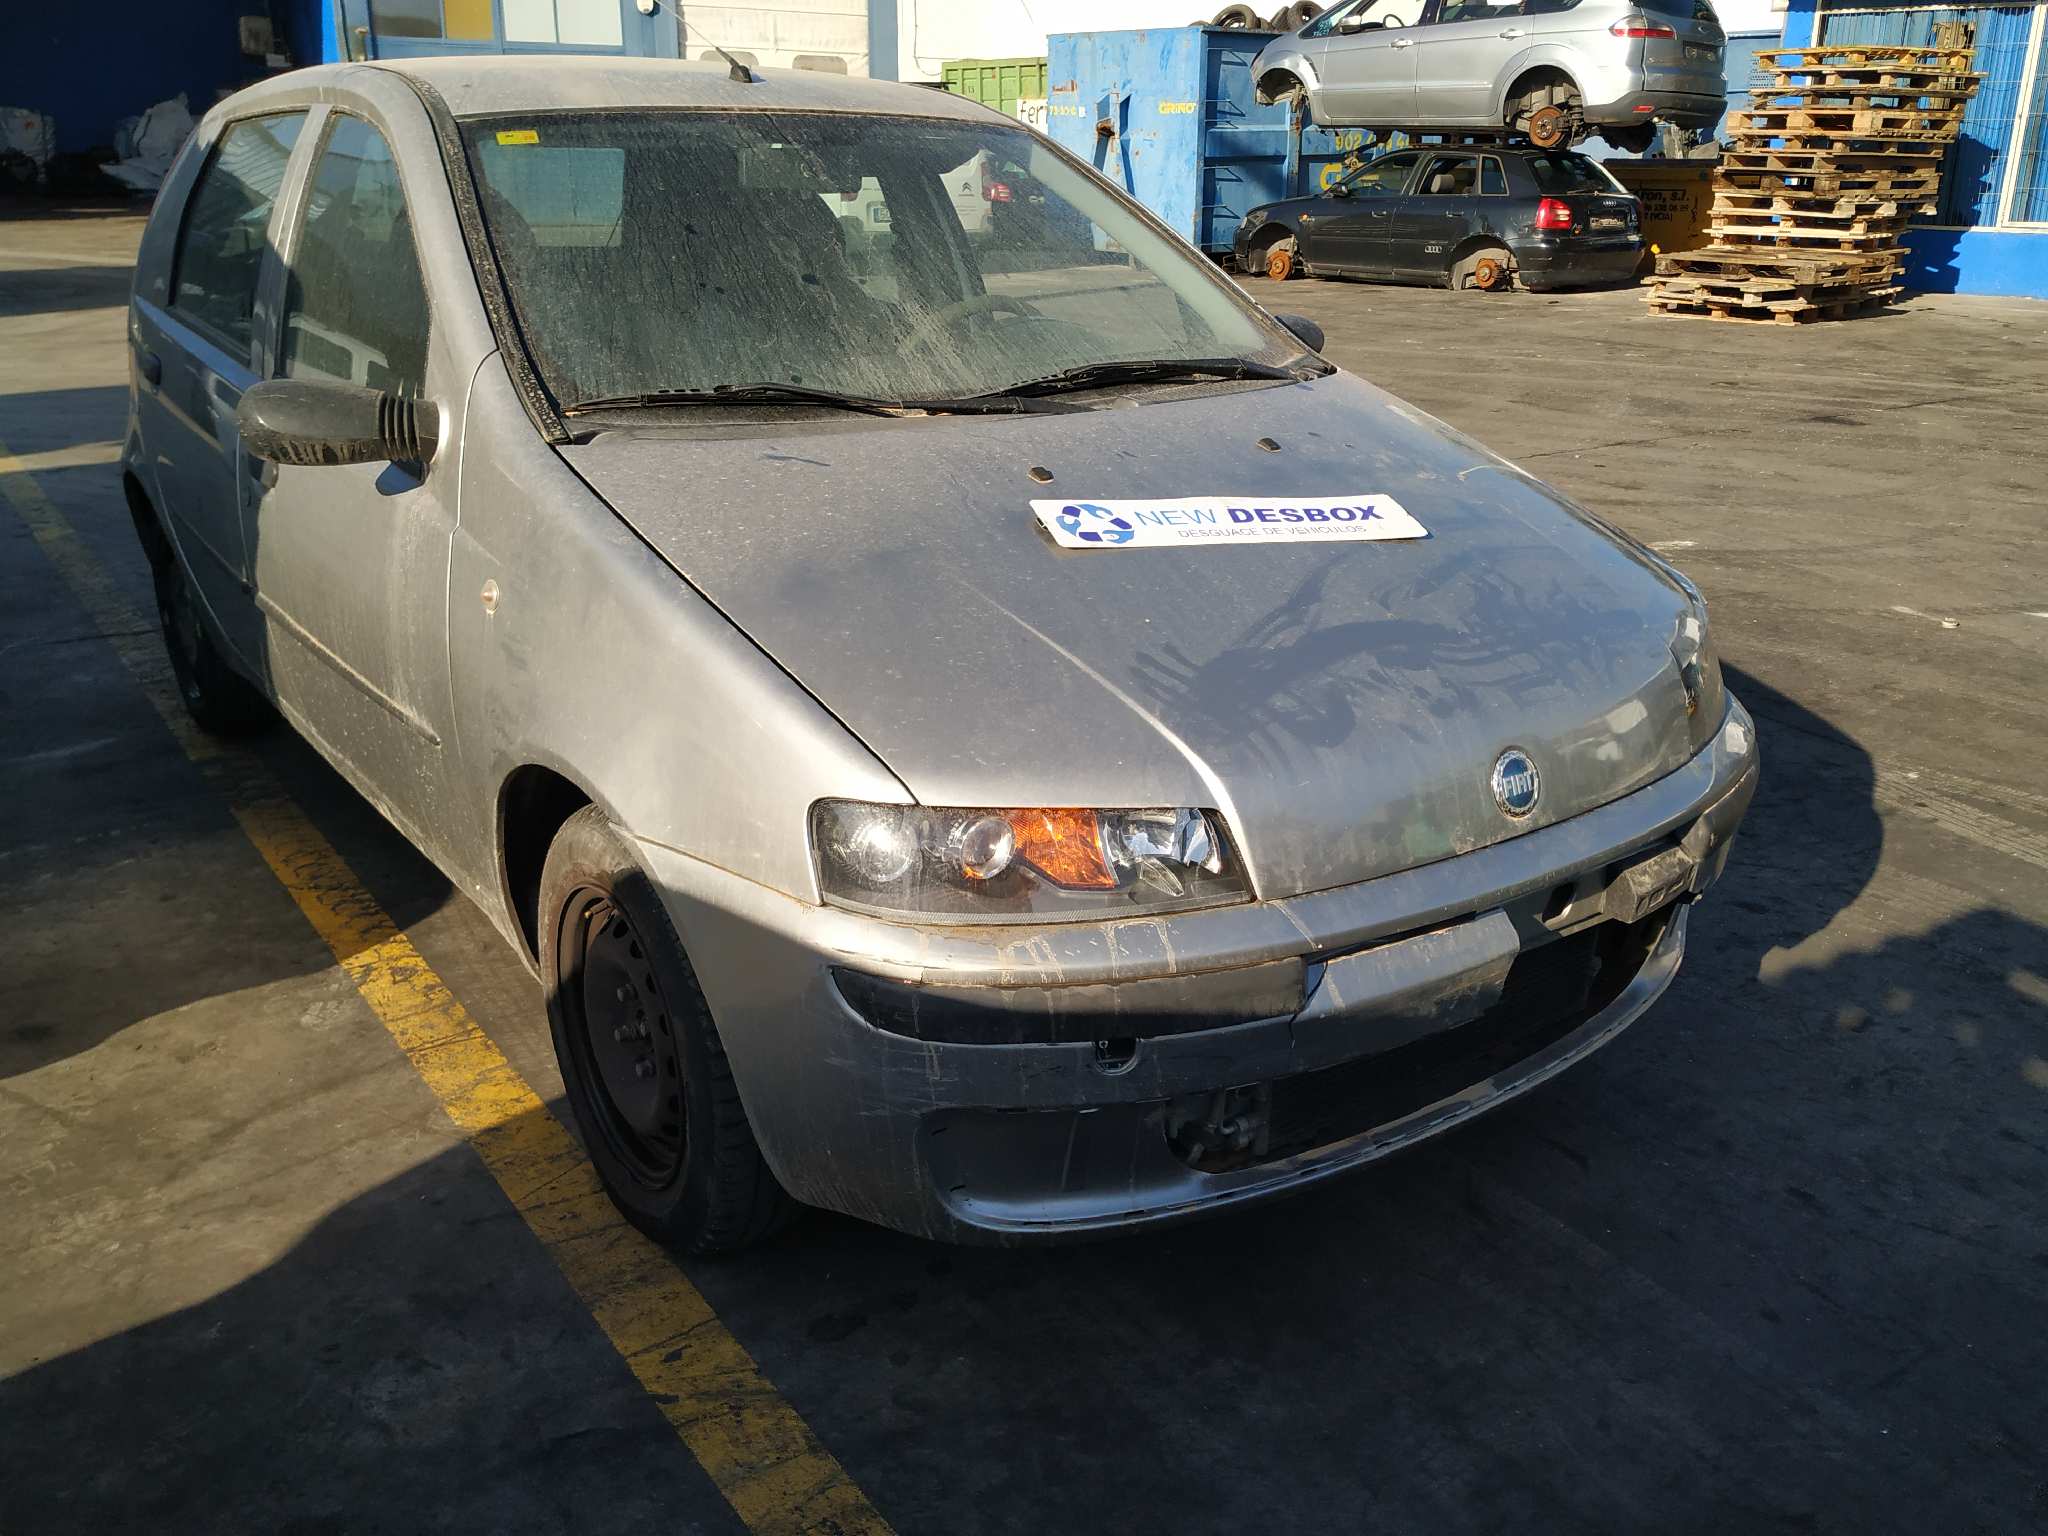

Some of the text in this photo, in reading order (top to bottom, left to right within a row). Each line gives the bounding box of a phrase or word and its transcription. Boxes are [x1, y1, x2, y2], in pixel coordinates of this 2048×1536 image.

[1134, 505, 1385, 526] NEW DESBOX
[1177, 527, 1258, 539] DESGUACE
[1263, 526, 1284, 537] DE
[1502, 770, 1533, 798] FIAT
